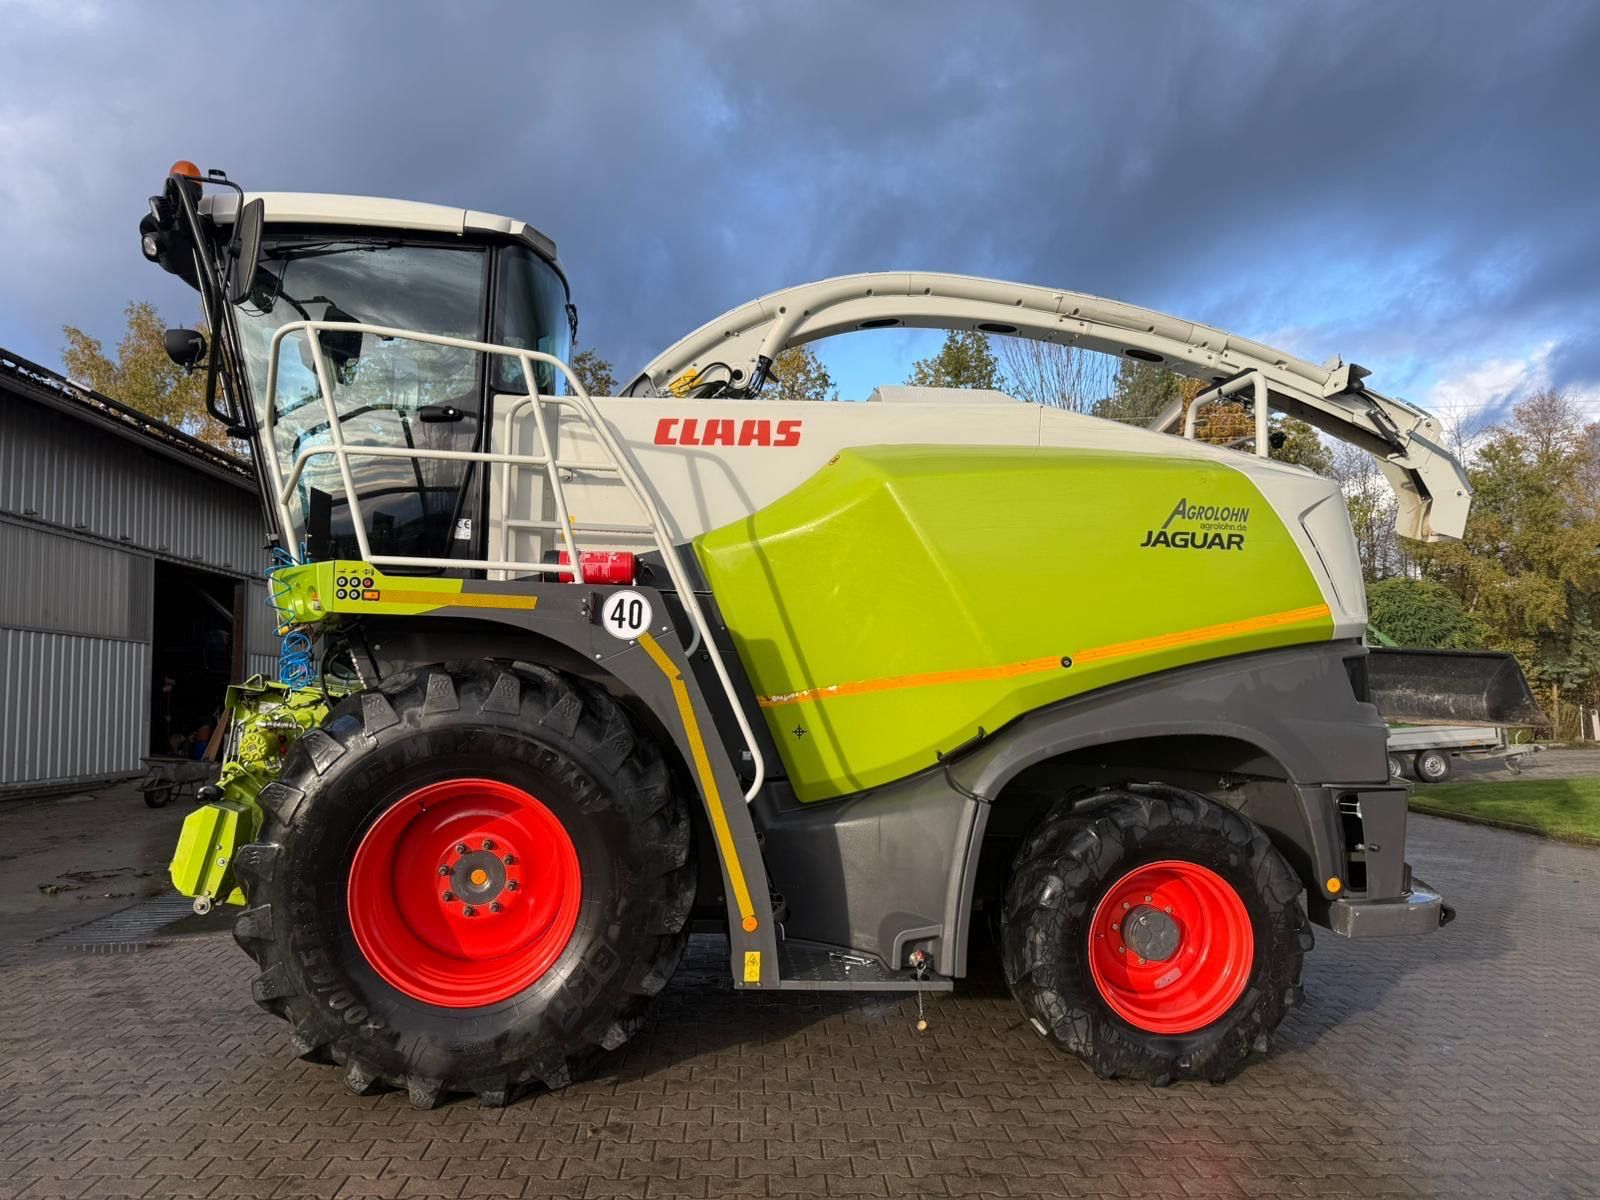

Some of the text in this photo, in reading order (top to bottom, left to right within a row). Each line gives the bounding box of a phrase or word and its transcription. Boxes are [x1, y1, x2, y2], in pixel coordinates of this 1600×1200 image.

[654, 418, 802, 446] CLAAS
[1200, 521, 1248, 531] agrolohn.de
[1140, 530, 1245, 551] JAGUAR
[611, 598, 643, 629] 40
